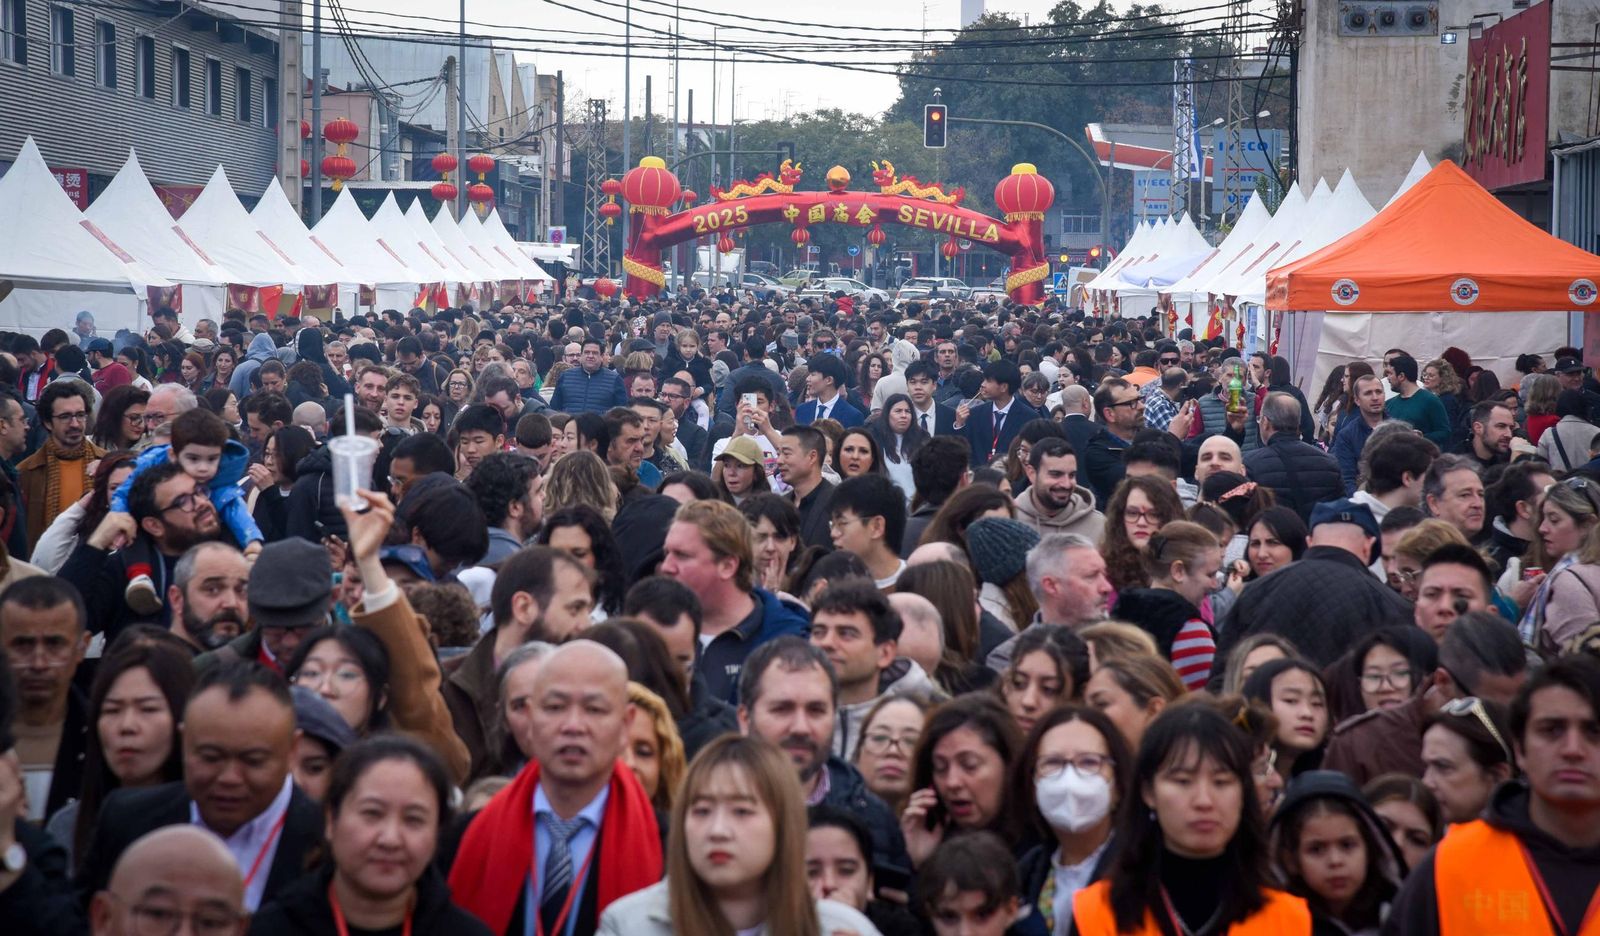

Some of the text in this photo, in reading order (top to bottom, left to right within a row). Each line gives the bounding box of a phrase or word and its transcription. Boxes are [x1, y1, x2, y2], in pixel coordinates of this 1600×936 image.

[693, 205, 749, 233] 2025
[897, 204, 1000, 242] SEVILLA
[1464, 888, 1528, 921] 中国
